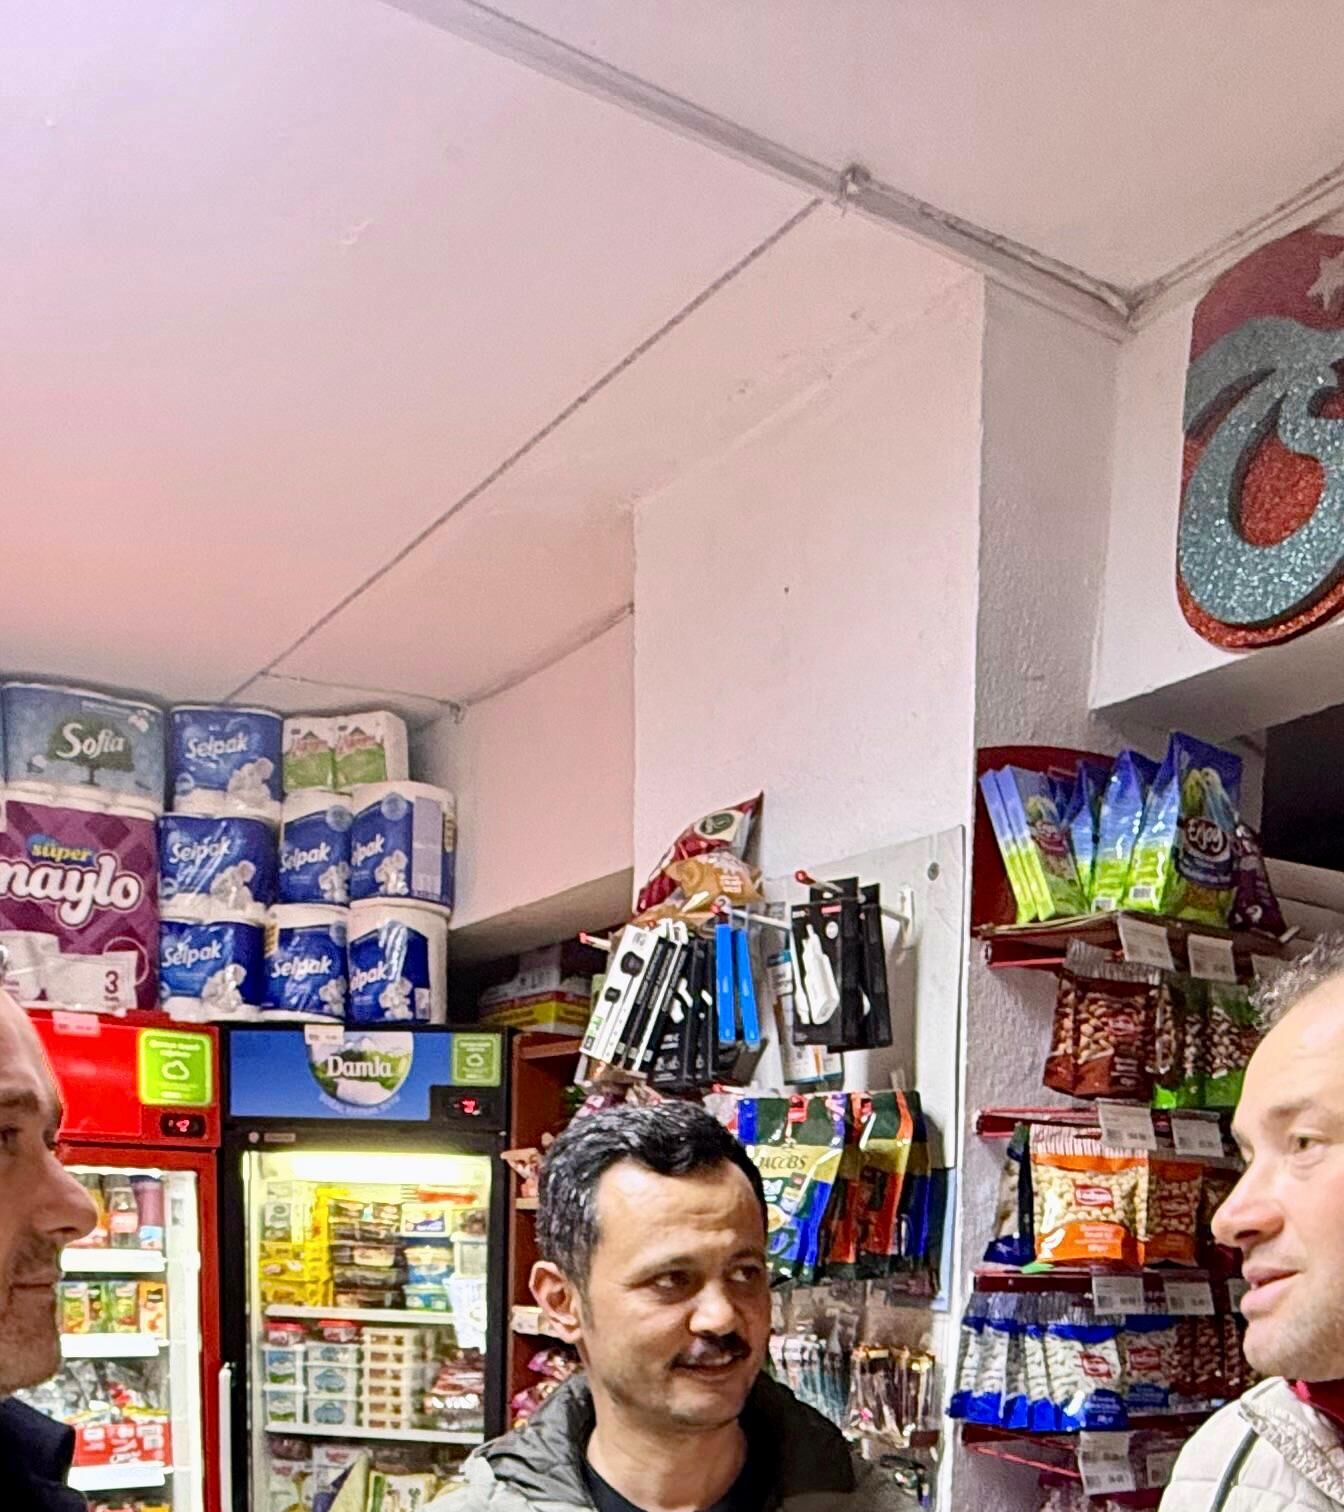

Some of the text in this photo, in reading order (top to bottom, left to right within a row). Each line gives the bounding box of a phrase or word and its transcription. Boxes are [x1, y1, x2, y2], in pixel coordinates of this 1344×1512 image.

[61, 722, 127, 760] Sofia
[183, 731, 250, 759] Selpak
[168, 835, 232, 864] Selpak
[160, 941, 222, 969] Selpak
[270, 955, 333, 981] Selpak
[104, 970, 119, 994] 3
[326, 1055, 392, 1078] Damla
[759, 1154, 809, 1171] JACOBS
